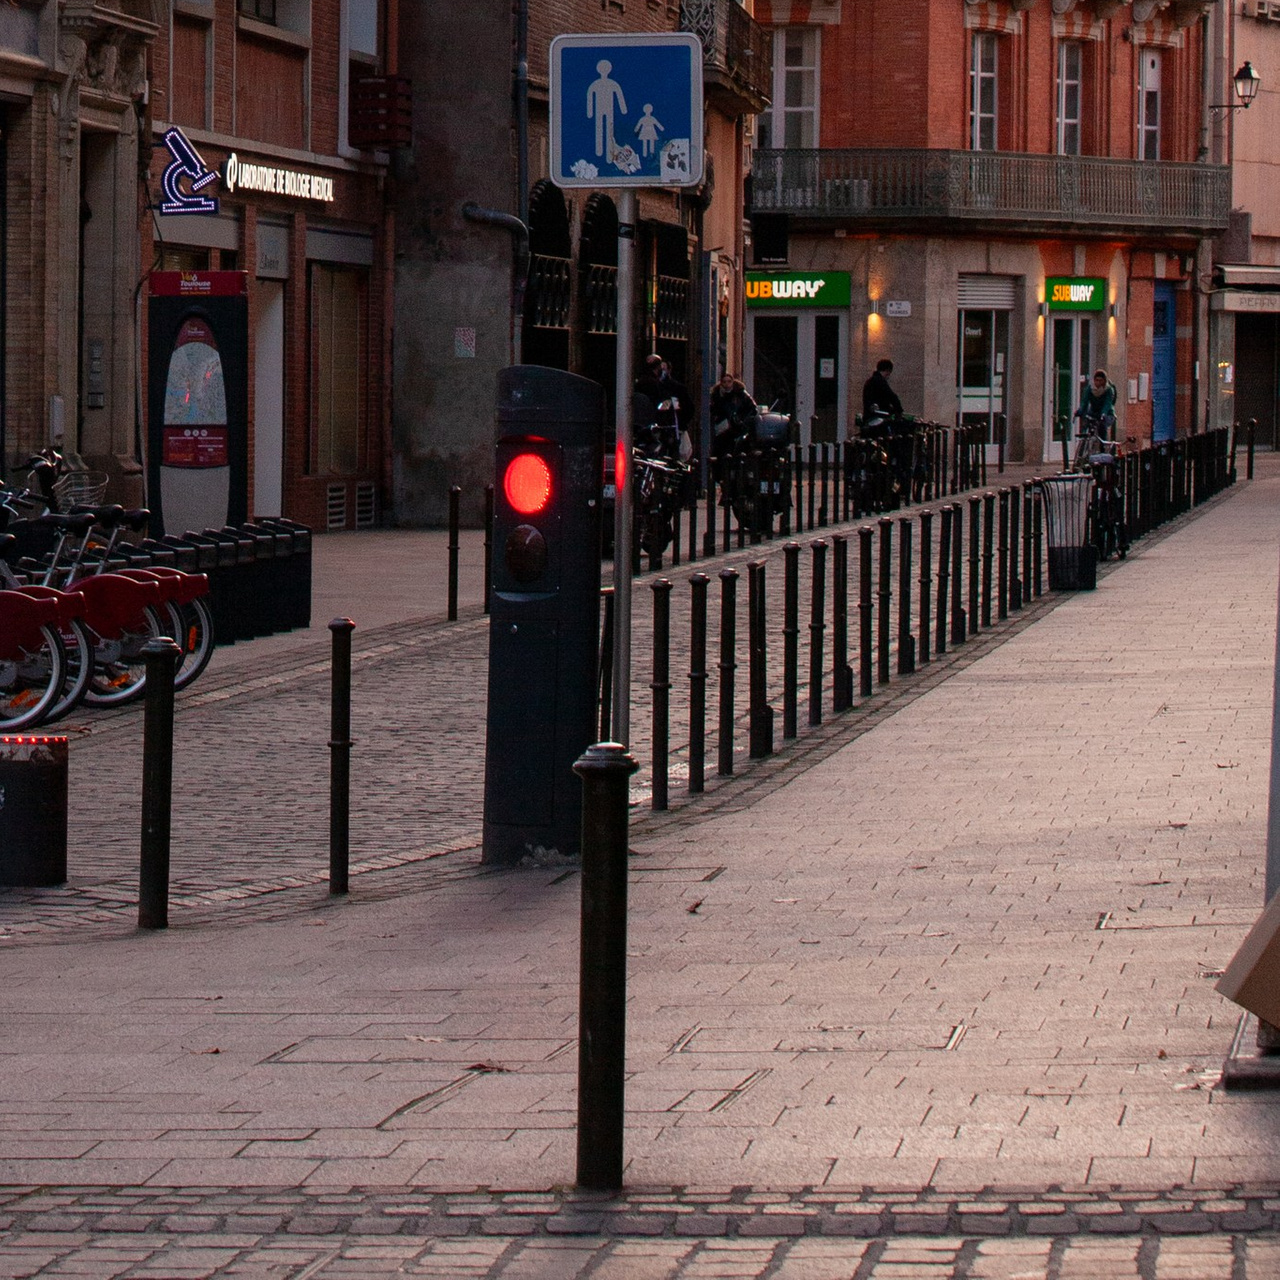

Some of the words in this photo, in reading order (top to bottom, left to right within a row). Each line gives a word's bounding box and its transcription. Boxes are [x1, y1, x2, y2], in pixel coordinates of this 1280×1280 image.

[238, 162, 276, 193] LABORATOIRE
[276, 169, 284, 194] DE
[285, 170, 310, 198] BIOLOGIE
[746, 280, 826, 299] UBWAY
[1051, 284, 1095, 302] SUBWAY
